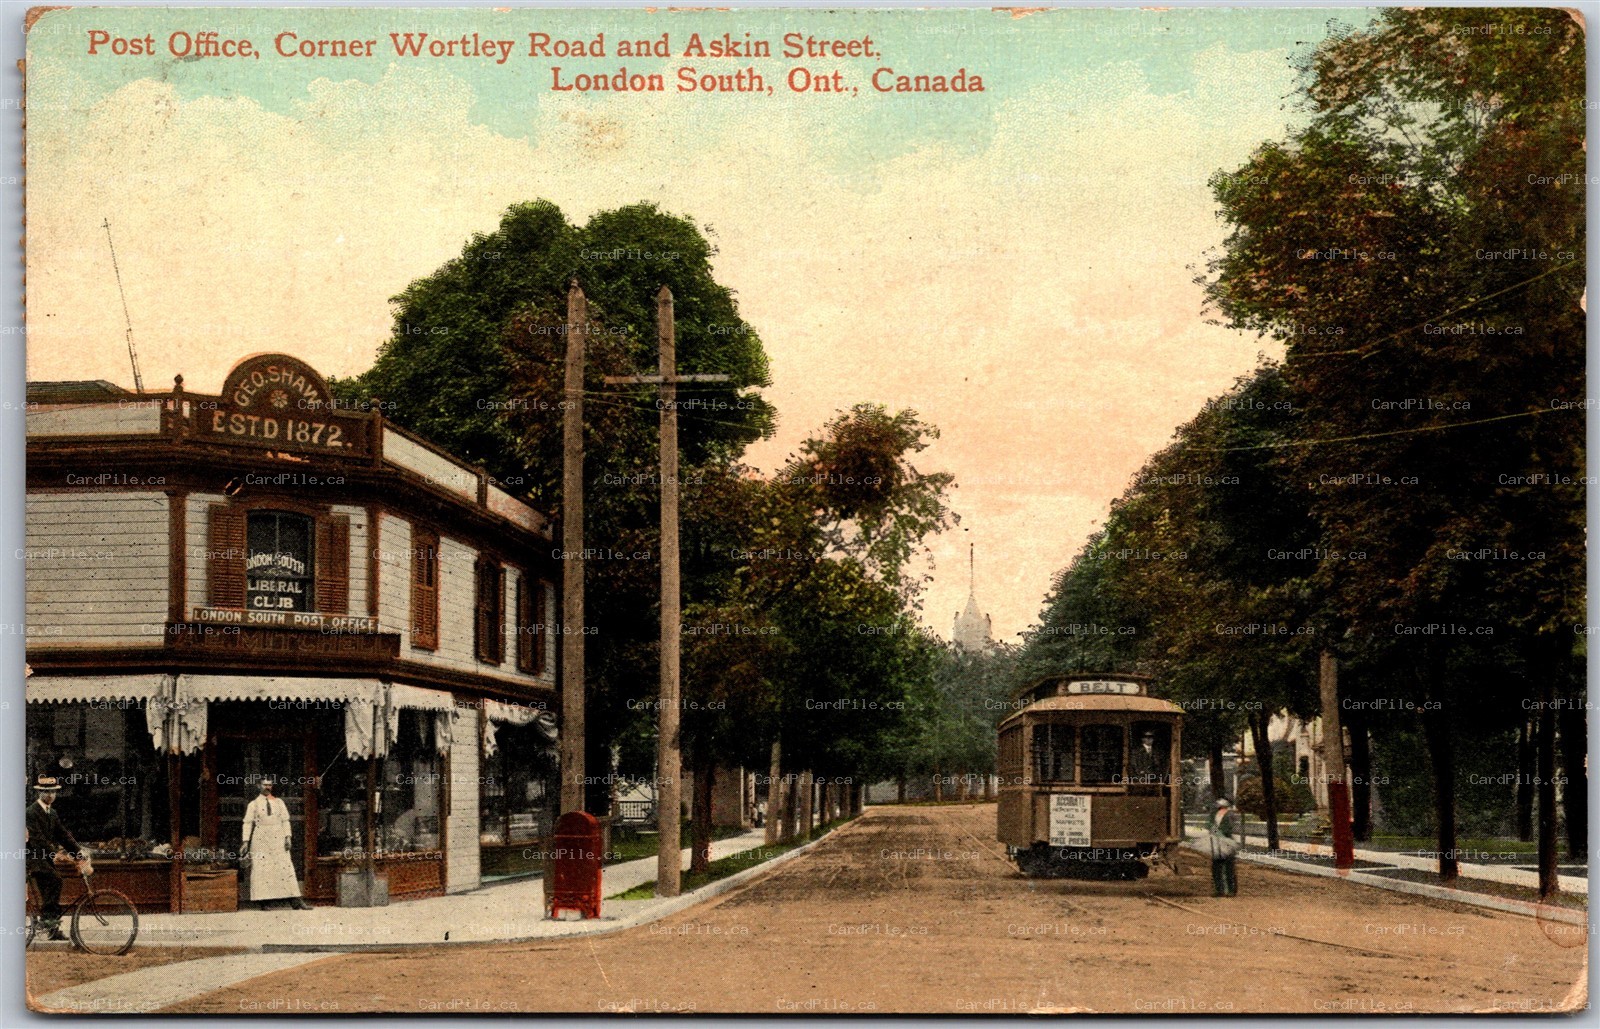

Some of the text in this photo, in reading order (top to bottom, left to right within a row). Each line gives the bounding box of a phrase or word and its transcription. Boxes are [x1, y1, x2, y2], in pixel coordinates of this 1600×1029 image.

[287, 418, 353, 447] 1872.
[247, 579, 303, 593] LIBERAL
[193, 609, 376, 630] LONDON SOUTH POST OFFICE
[1080, 682, 1126, 693] BELT
